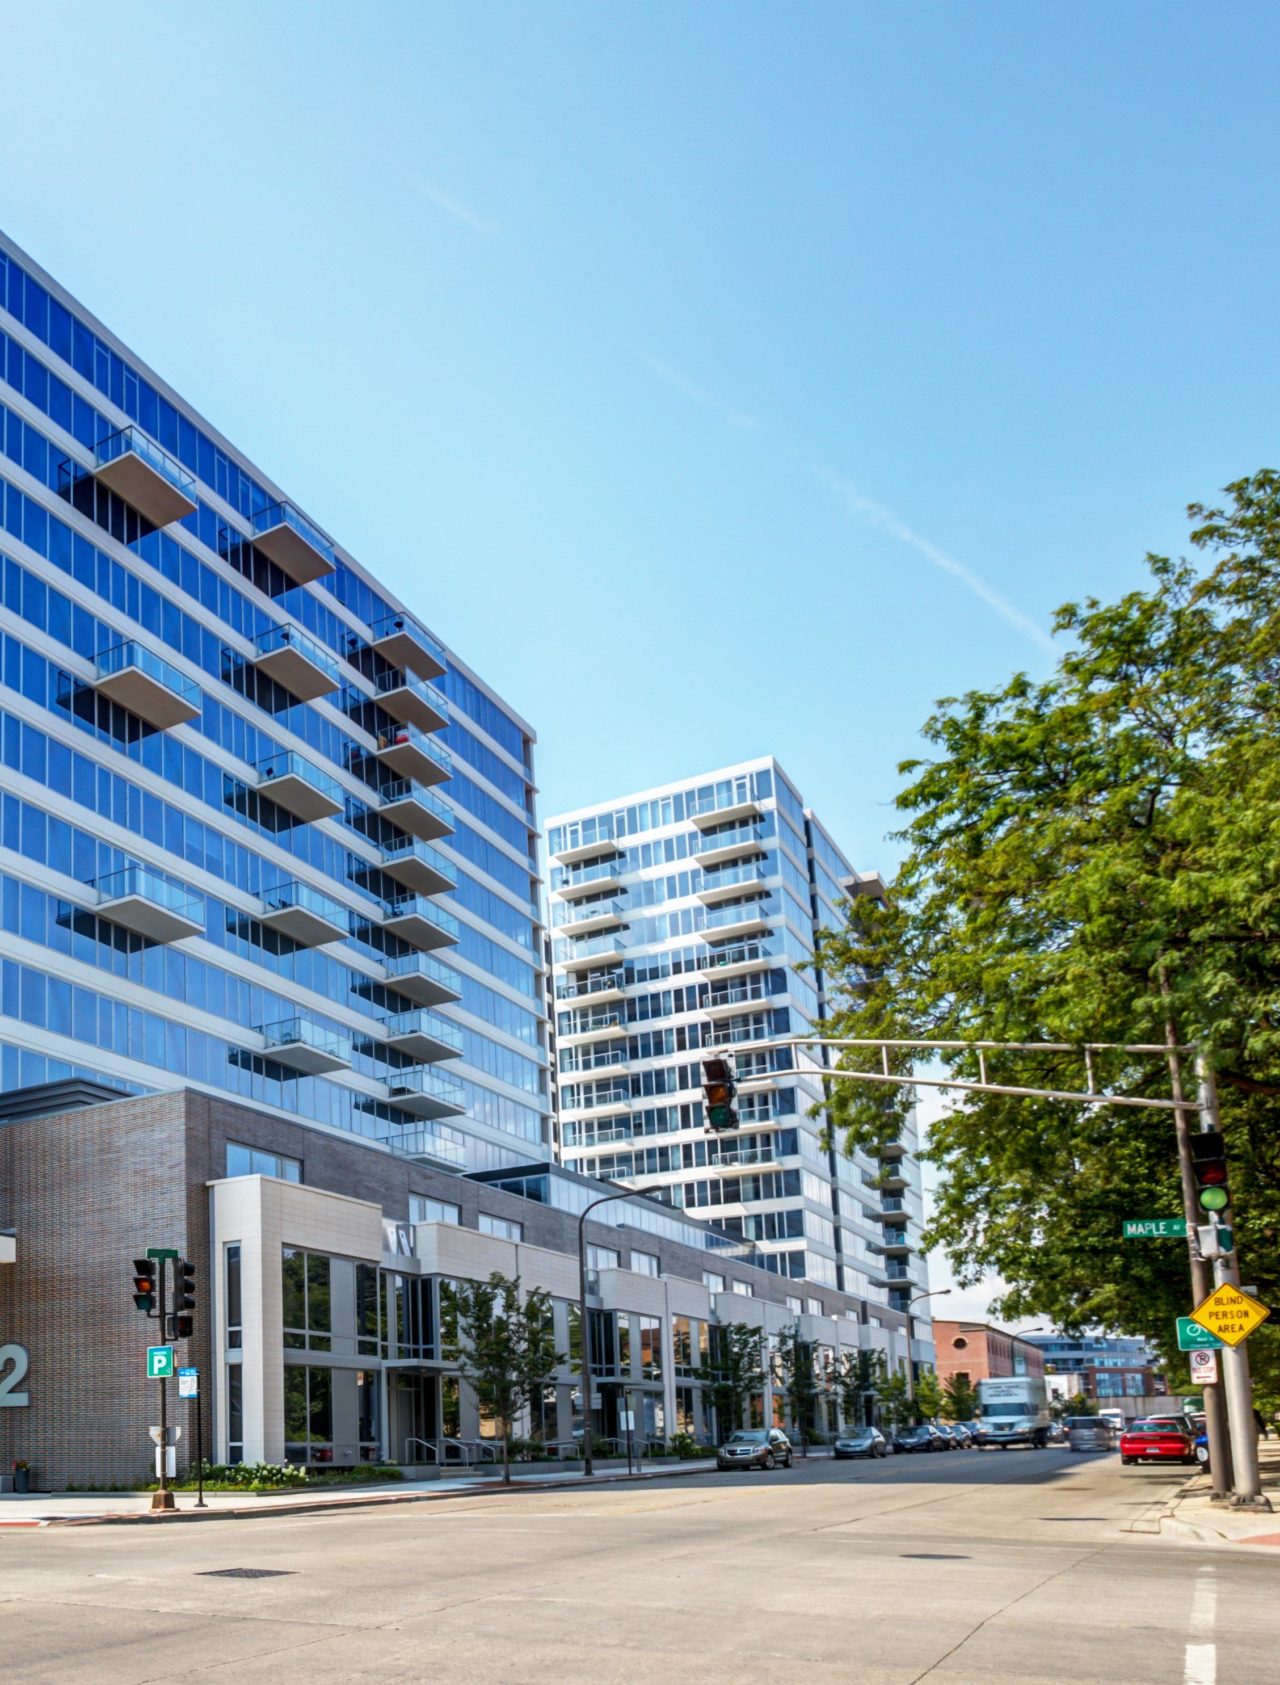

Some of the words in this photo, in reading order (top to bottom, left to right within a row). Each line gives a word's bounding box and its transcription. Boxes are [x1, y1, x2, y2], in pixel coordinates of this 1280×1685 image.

[1126, 1221, 1168, 1235] MAPLE
[1213, 1295, 1244, 1306] BLIND
[1208, 1309, 1250, 1321] PERSON
[1217, 1323, 1245, 1334] AREA
[153, 1355, 167, 1375] P
